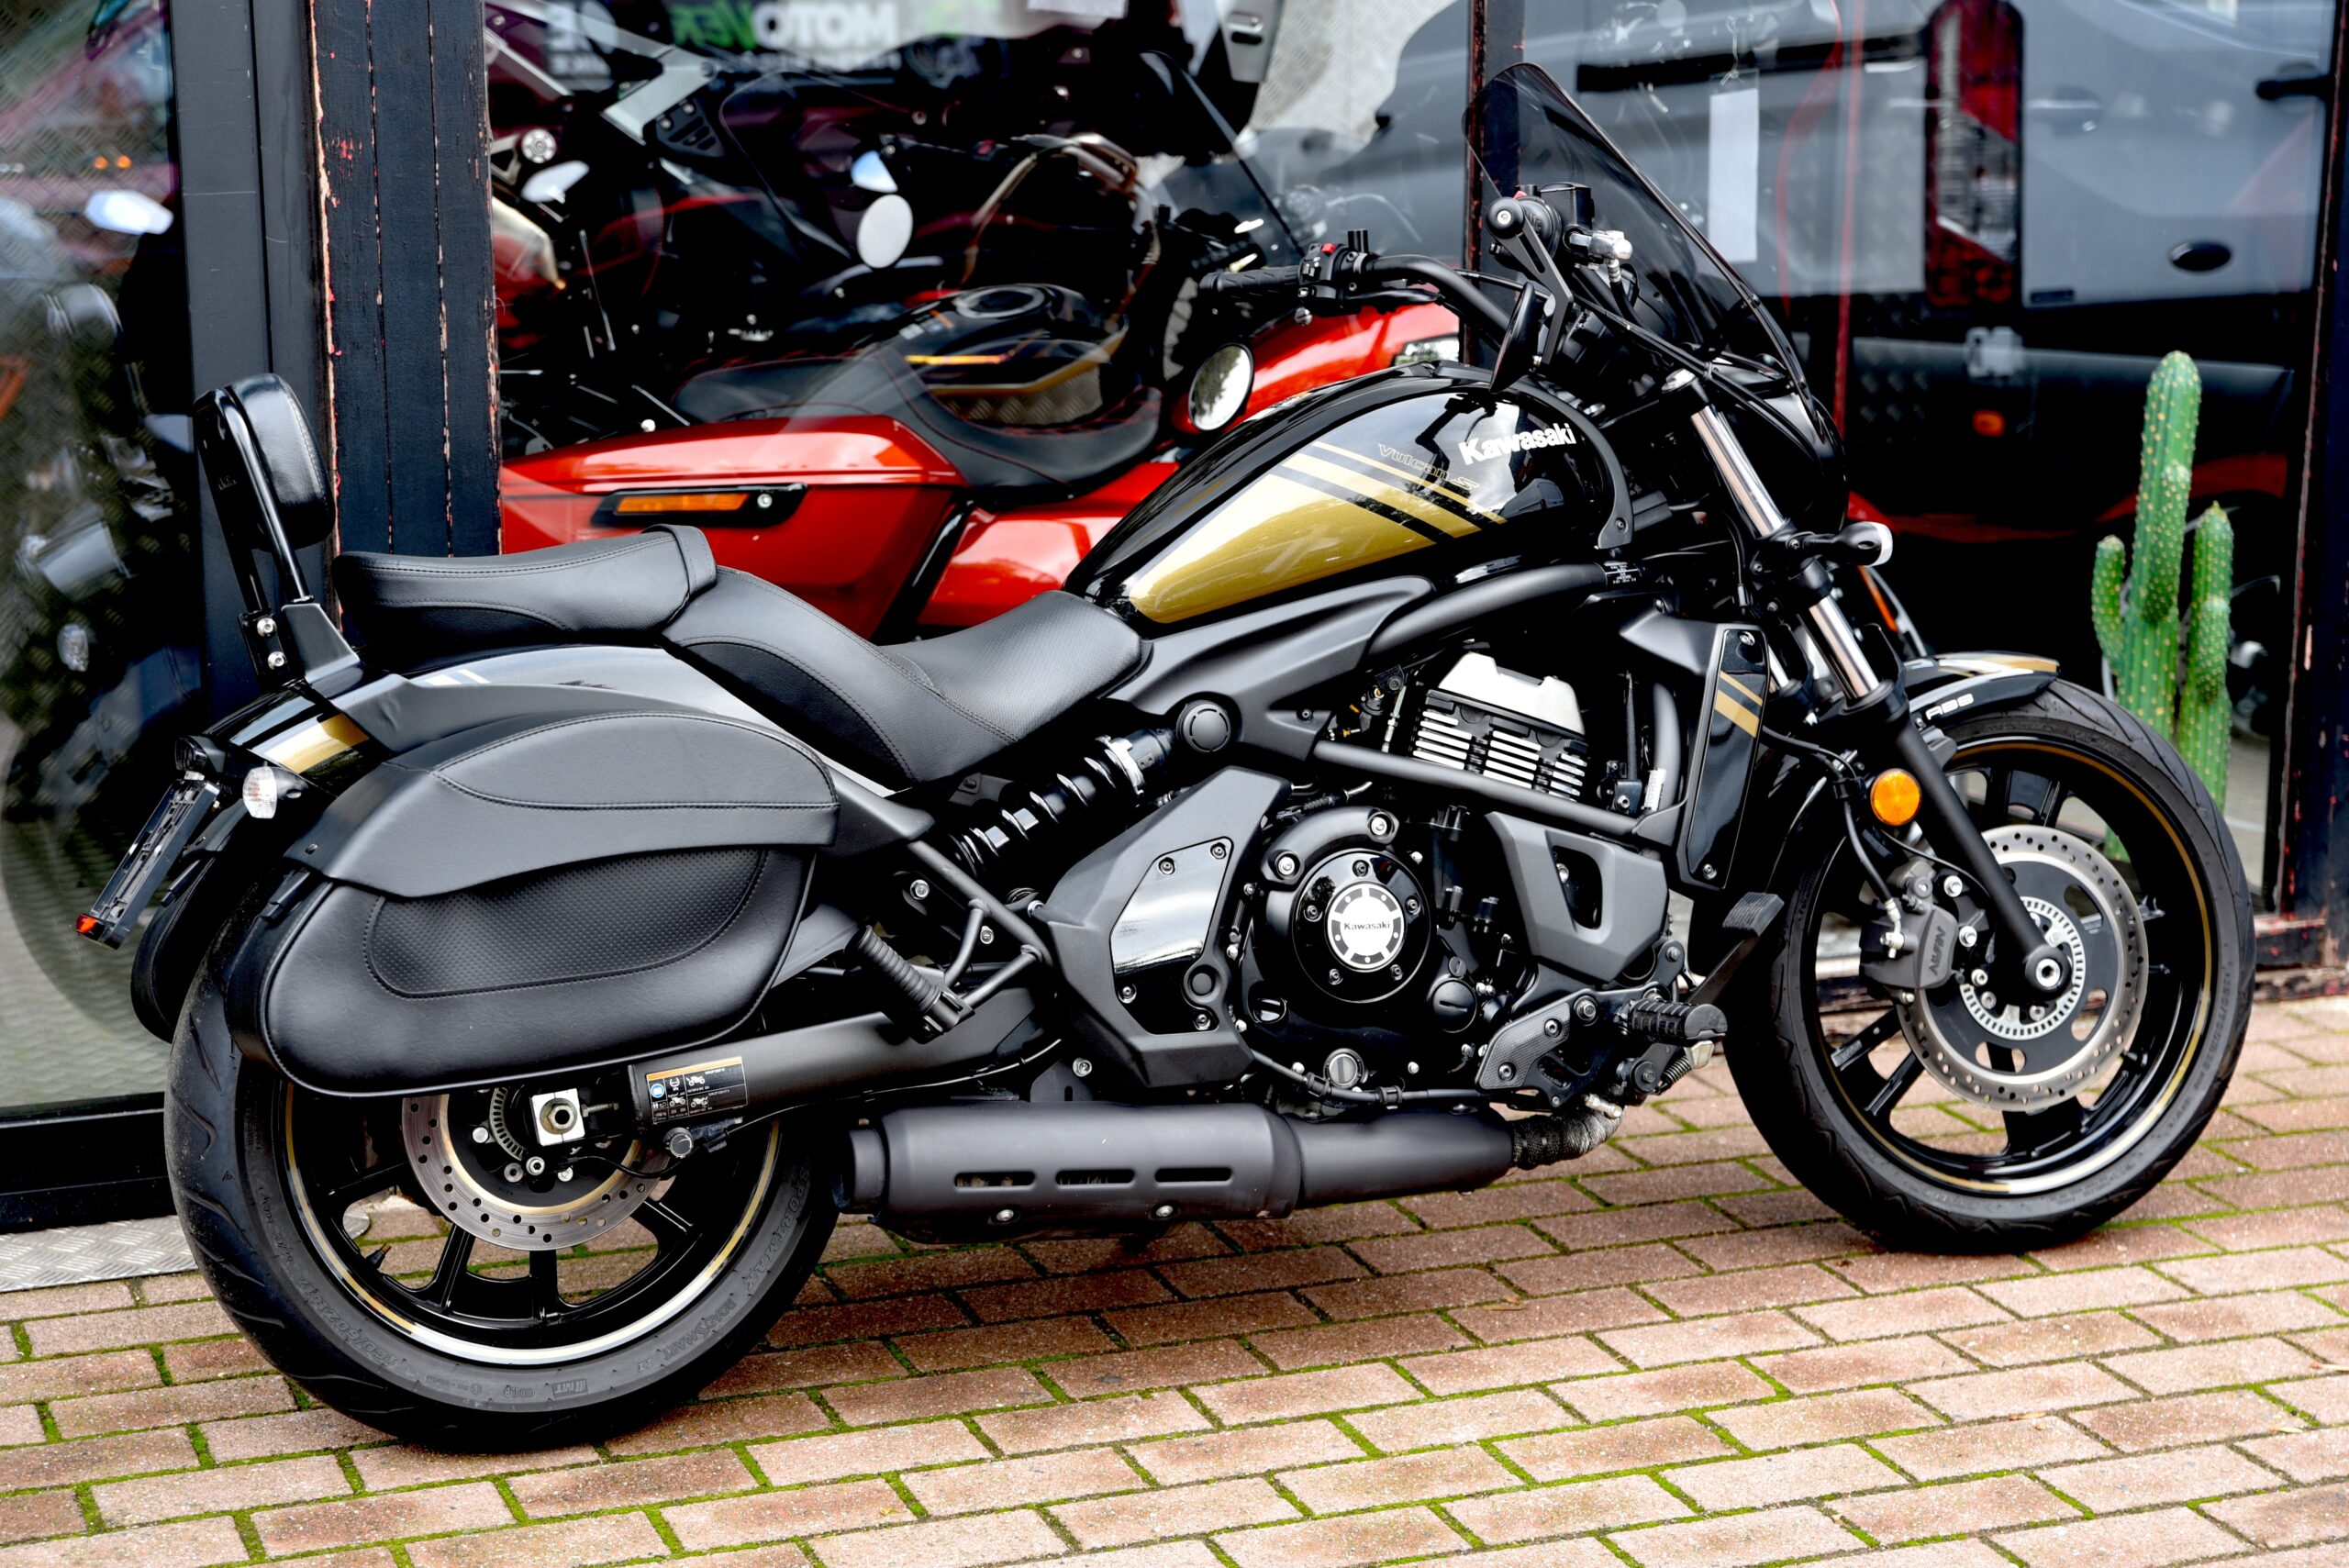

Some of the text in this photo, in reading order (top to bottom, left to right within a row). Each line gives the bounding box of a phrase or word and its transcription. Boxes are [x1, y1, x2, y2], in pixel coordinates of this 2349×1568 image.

[1378, 443, 1450, 483] Vulcan
[1458, 422, 1577, 465] Kawasaki
[1925, 694, 1974, 720] ABS
[1343, 921, 1390, 930] Kawasaki
[740, 1164, 814, 1293] SPORTMAX
